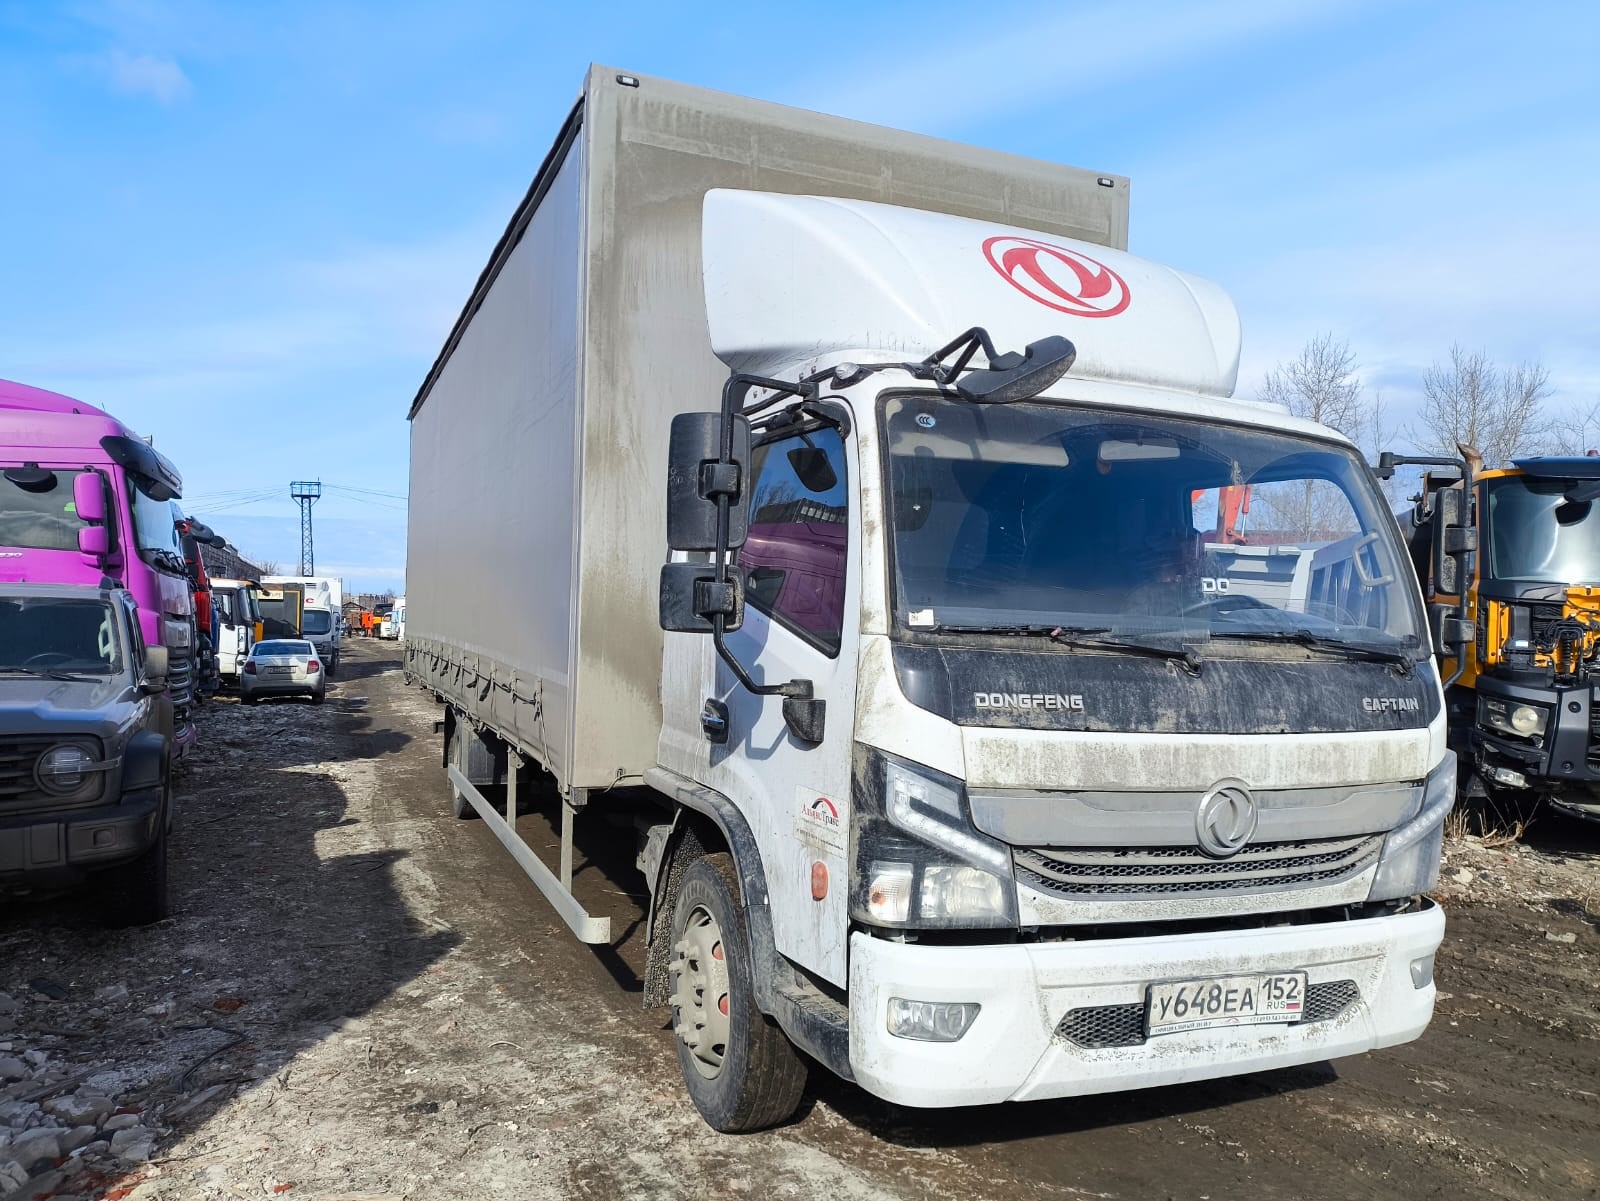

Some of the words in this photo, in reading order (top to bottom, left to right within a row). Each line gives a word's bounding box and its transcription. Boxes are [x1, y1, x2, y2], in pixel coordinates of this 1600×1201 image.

[974, 692, 1084, 711] DONGFENG
[1362, 697, 1419, 711] CAPTAIN
[1262, 977, 1299, 1000] 152
[1266, 1000, 1286, 1010] RUS
